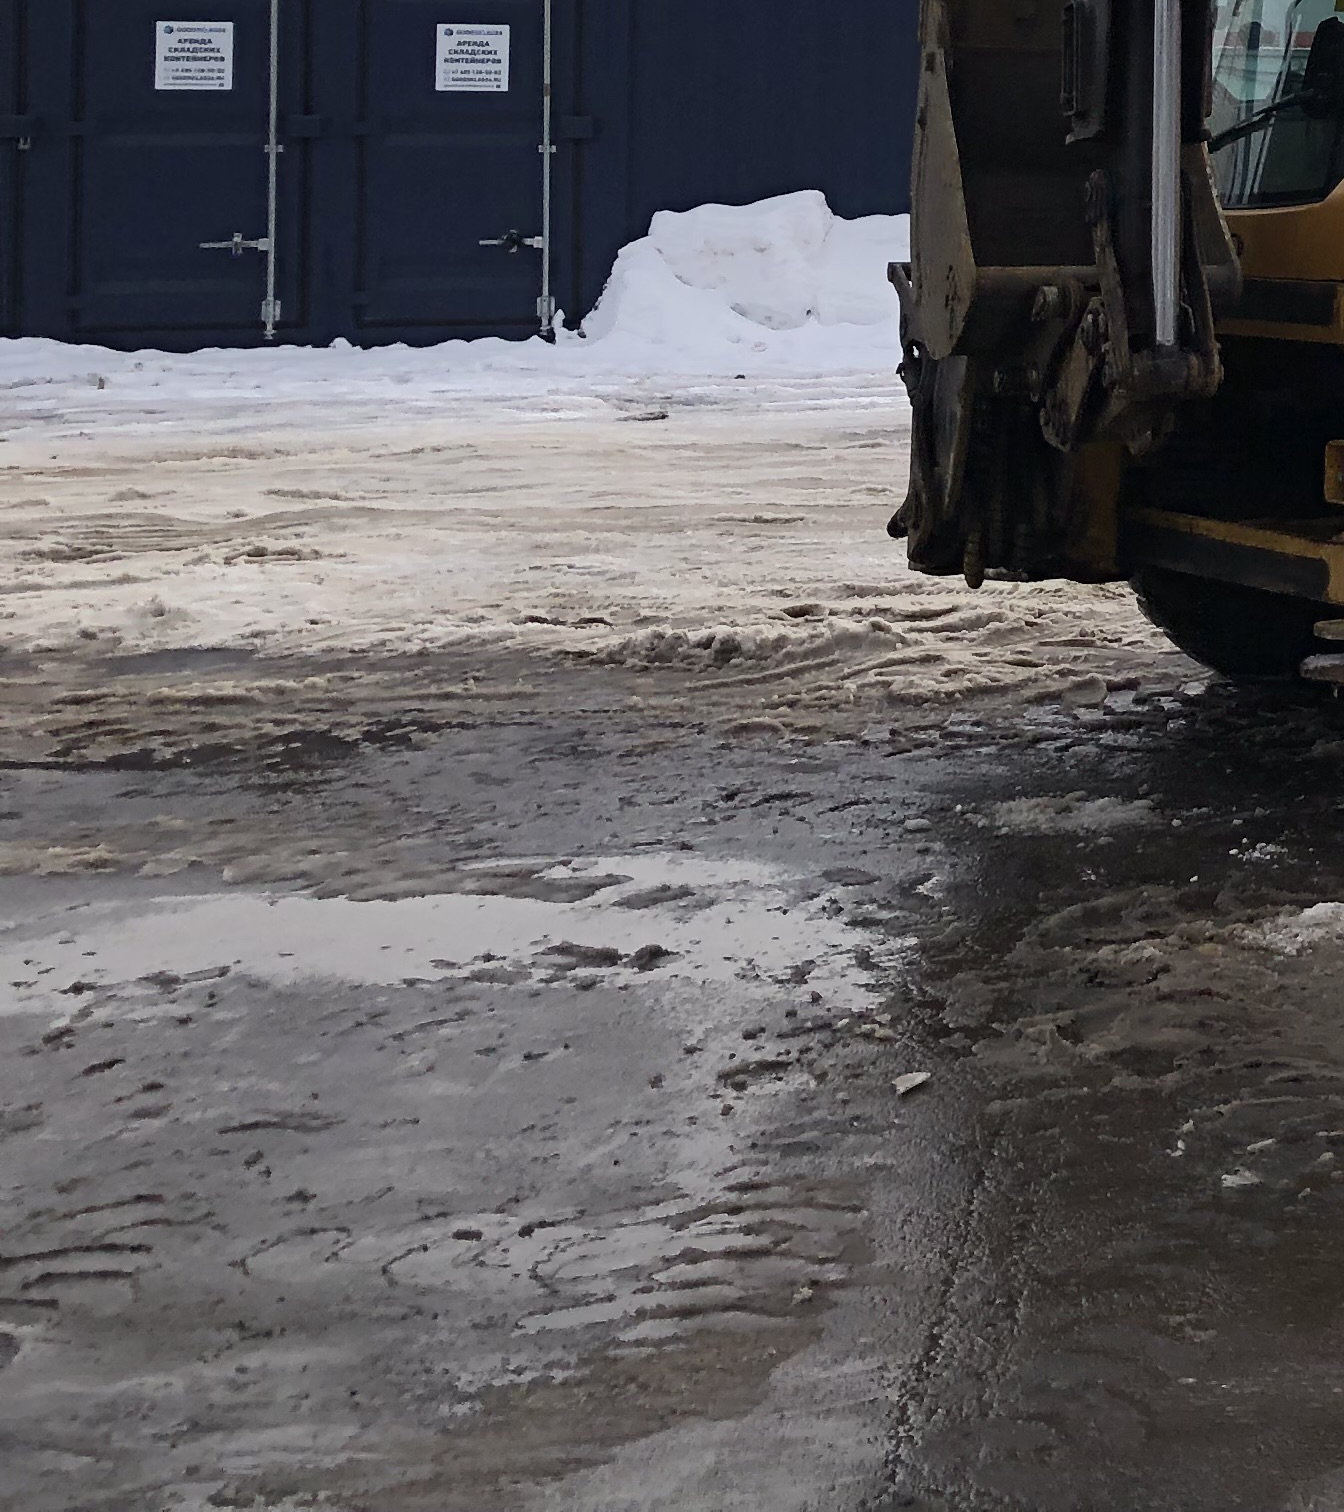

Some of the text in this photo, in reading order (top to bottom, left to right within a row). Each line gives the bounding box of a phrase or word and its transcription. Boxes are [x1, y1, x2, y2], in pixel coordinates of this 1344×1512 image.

[177, 38, 213, 46] АРЕНДА
[456, 40, 490, 48] АРЕНДА
[168, 46, 221, 54] СКЛАДСКИХ
[448, 48, 498, 56] СКЛАДСКИХ
[163, 55, 226, 63] КОНТЕЙНЕРОВ
[443, 57, 502, 65] КОНТЕЙНЕРОВ
